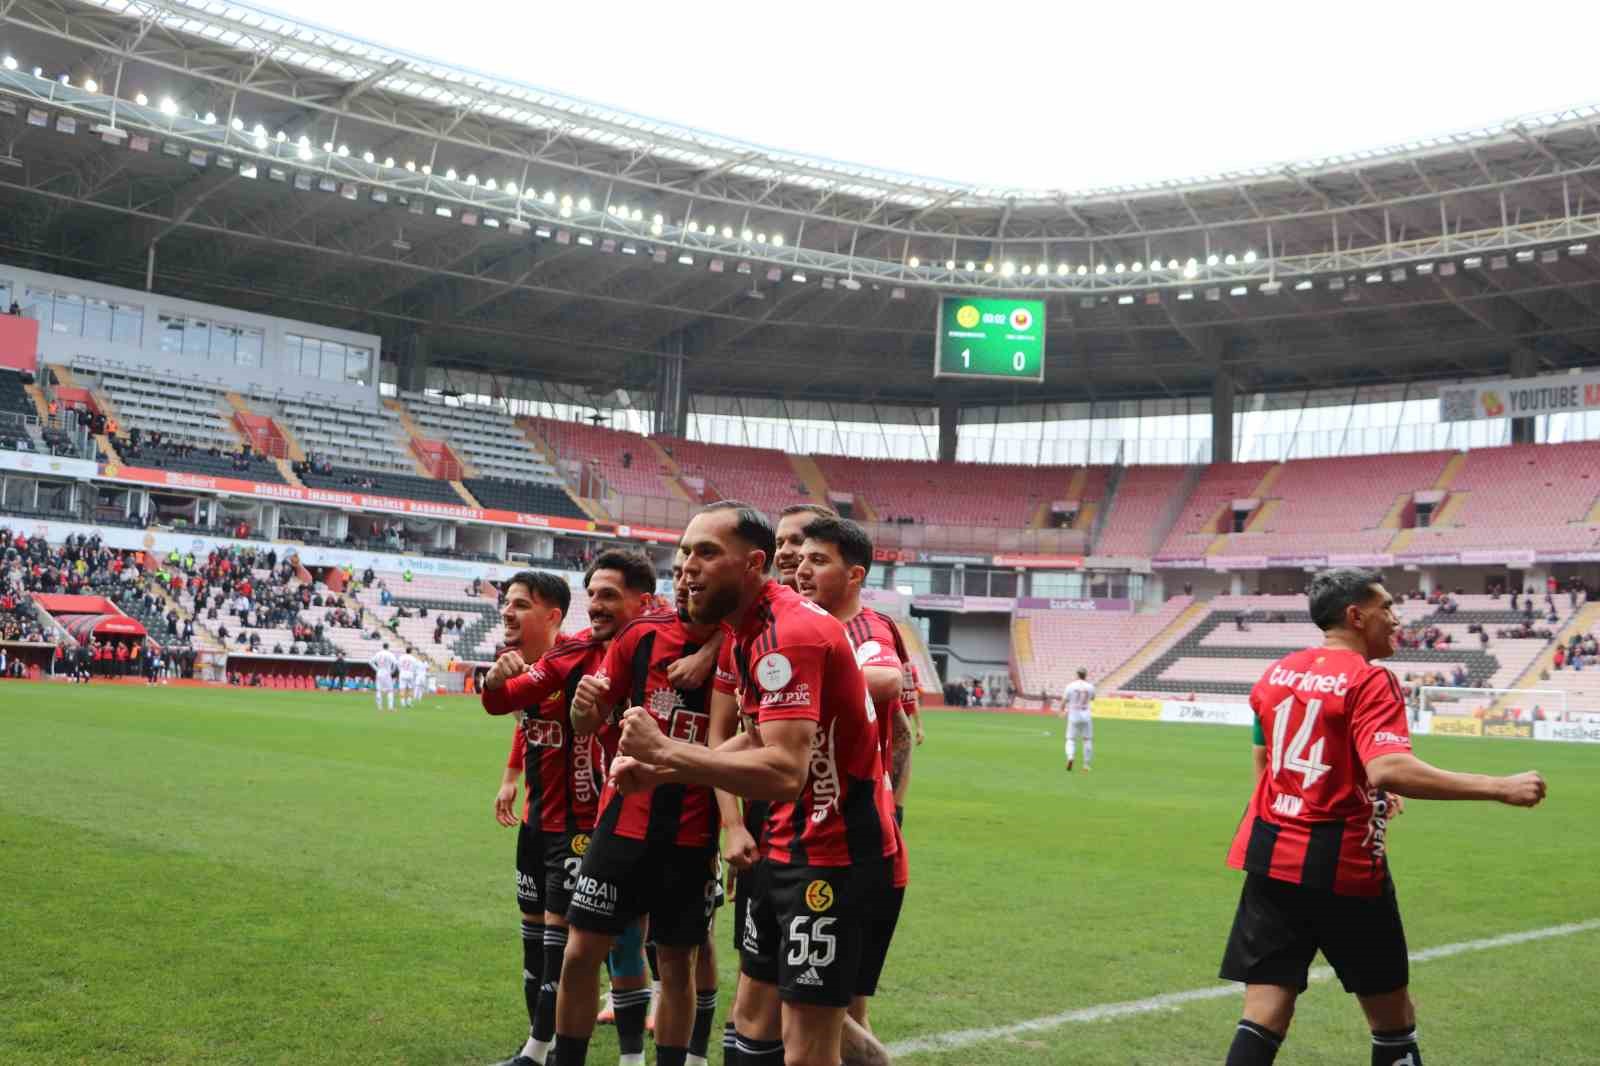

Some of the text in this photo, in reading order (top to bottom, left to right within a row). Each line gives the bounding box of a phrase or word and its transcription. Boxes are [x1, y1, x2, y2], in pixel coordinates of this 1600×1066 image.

[960, 347, 971, 369] 1
[1012, 351, 1026, 371] 0
[1509, 384, 1580, 411] YOUTUBE
[1268, 664, 1349, 697] turknet
[1272, 694, 1333, 790] 14
[787, 915, 838, 967] 55
